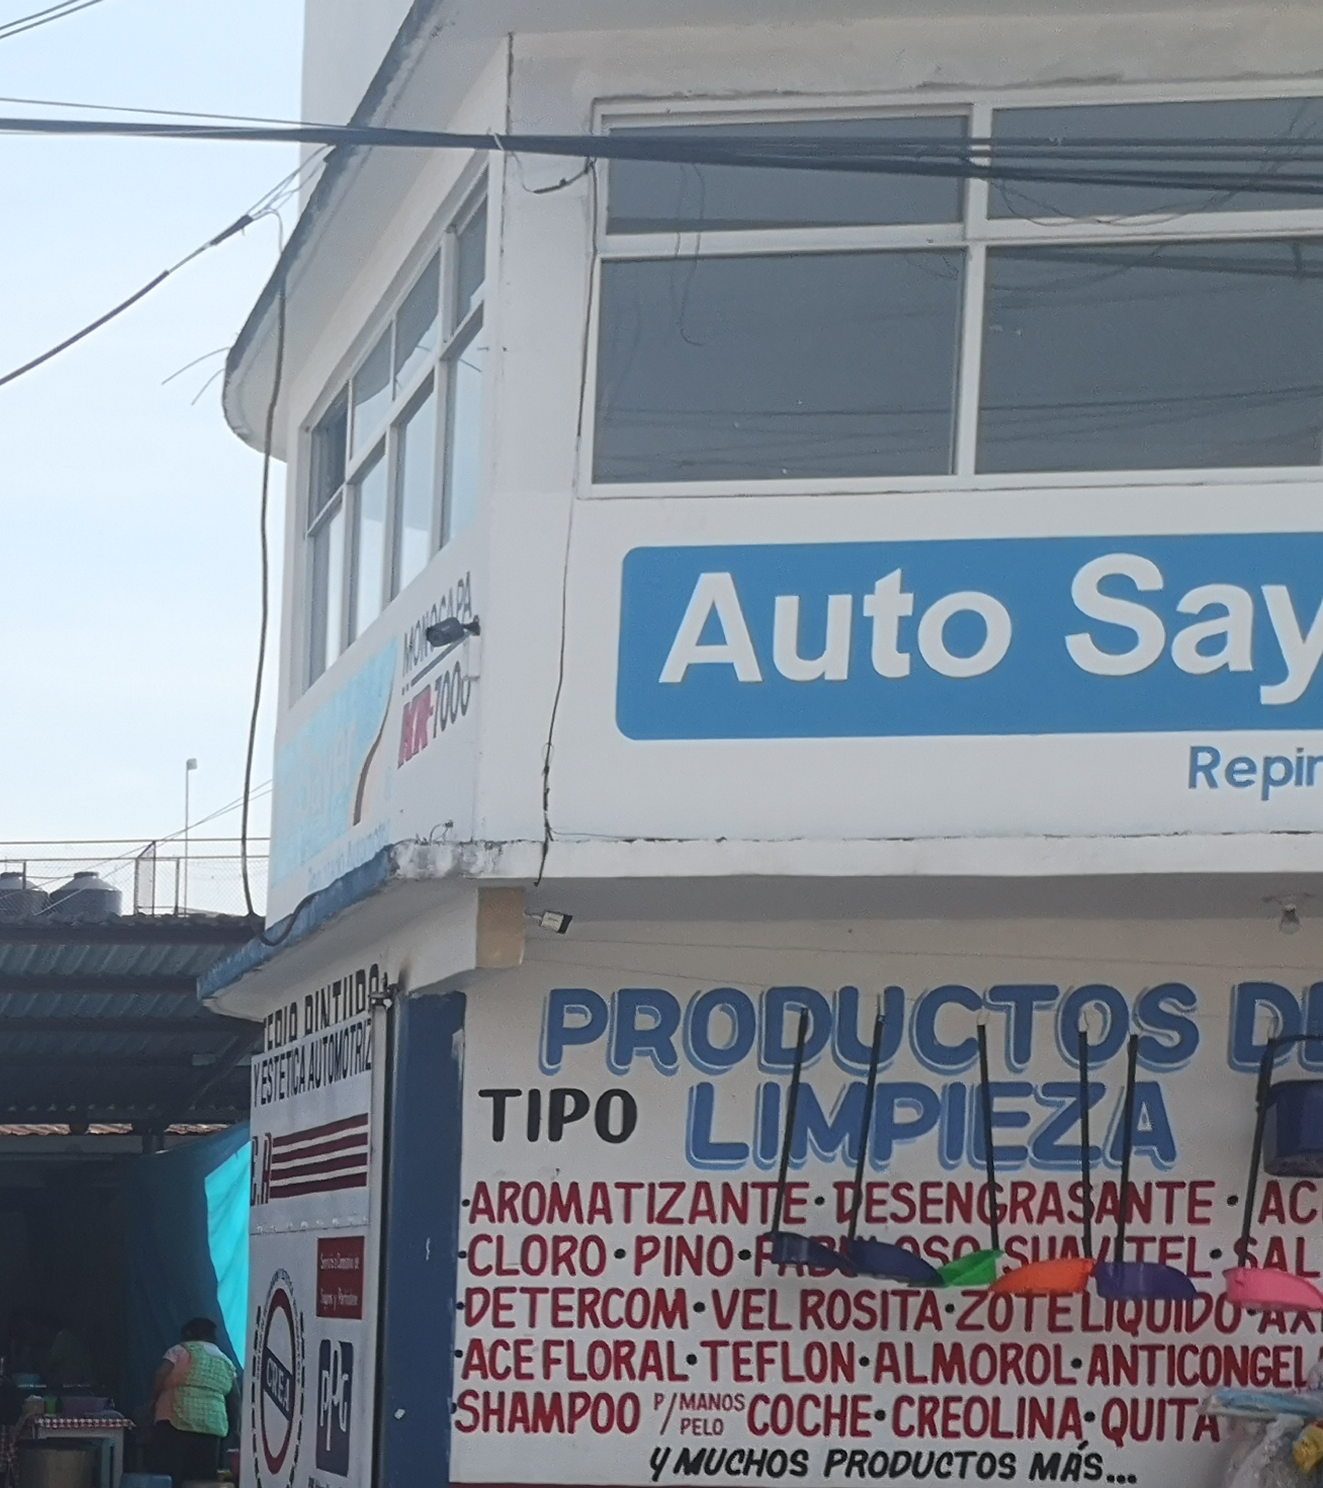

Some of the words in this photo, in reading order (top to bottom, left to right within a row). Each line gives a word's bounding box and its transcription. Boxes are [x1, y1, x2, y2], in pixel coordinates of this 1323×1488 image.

[658, 567, 1012, 684] Auto
[540, 983, 1200, 1076] PRODUCTOS
[478, 1087, 638, 1144] TIPO
[686, 1080, 1179, 1172] LIMPIEZA
[468, 1180, 810, 1225] AROMATIZANTE
[833, 1181, 1216, 1225] DESENGRASANTE
[1258, 1179, 1323, 1225] AC
[467, 1233, 607, 1278] CLORO
[633, 1234, 734, 1278] PINO
[464, 1286, 689, 1329] DETERCOM
[711, 1288, 793, 1331] VEL
[800, 1289, 944, 1333] ROSITA
[957, 1290, 1074, 1334] ZOTE
[1081, 1291, 1243, 1338] LIQUIDO
[461, 1338, 534, 1381] ACE
[542, 1339, 690, 1382] FLORAL
[699, 1340, 857, 1384] TEFLON
[873, 1342, 1077, 1385] ALMOROL
[1087, 1344, 1323, 1388] ANTICONGEL
[454, 1389, 641, 1435] SHAMPOO
[679, 1392, 746, 1412] MANOS
[746, 1393, 873, 1438] COCHE
[891, 1394, 1086, 1440] CREOLINA
[680, 1417, 724, 1436] PELO
[672, 1447, 809, 1479] MUCHOS
[823, 1449, 1016, 1480] PRODUCTOS
